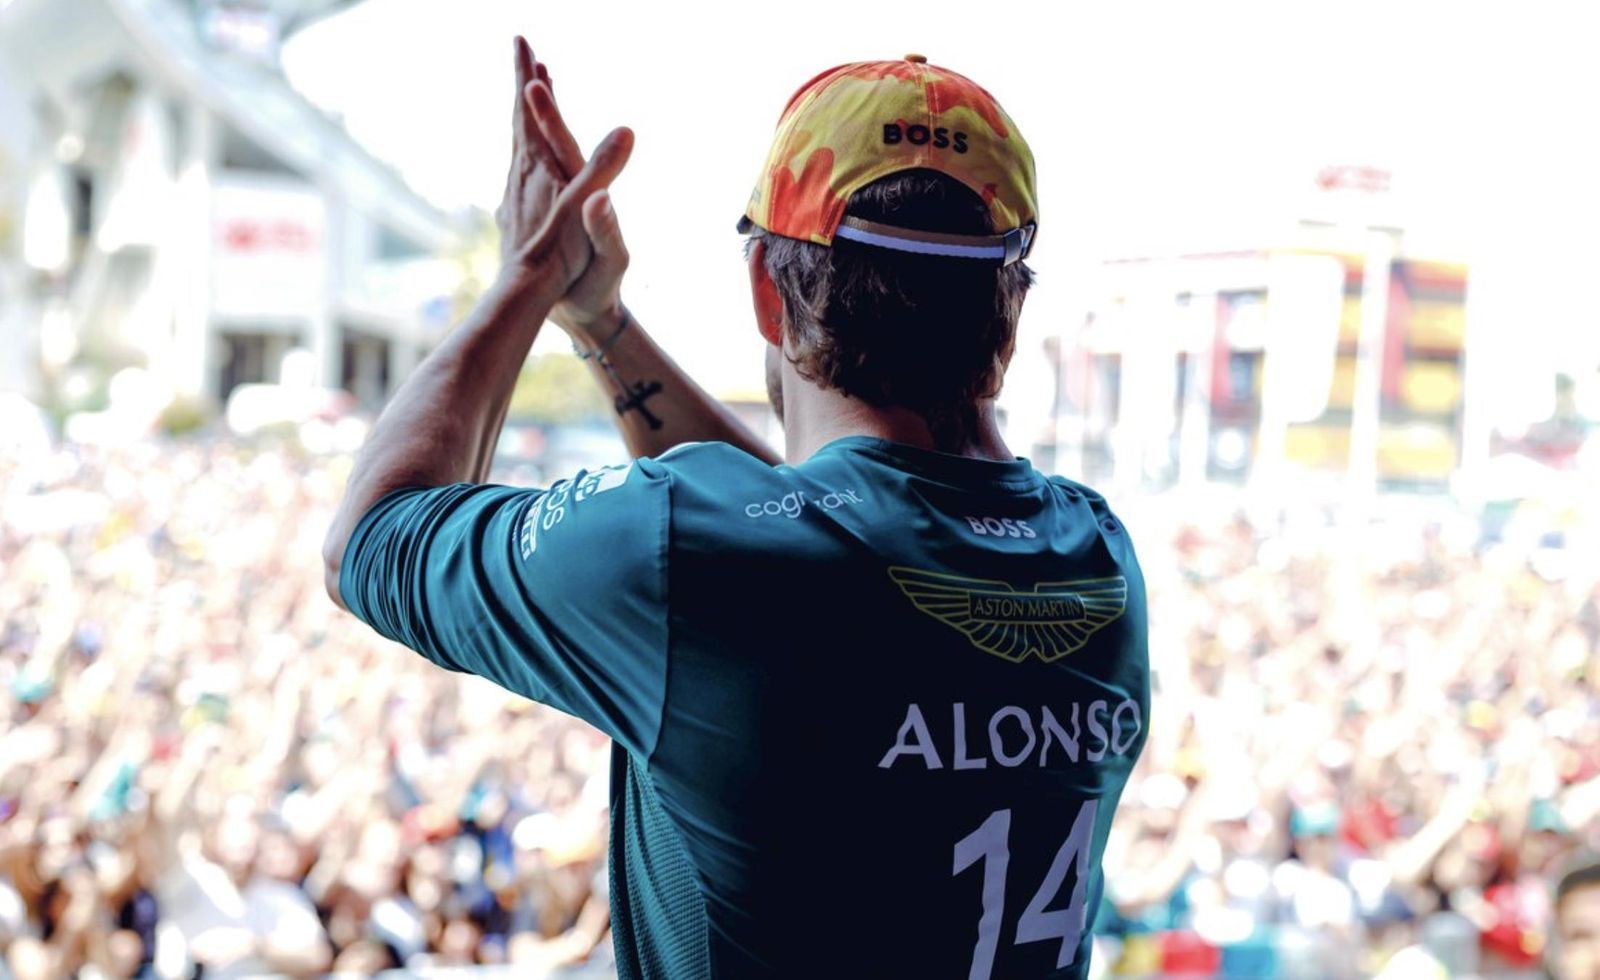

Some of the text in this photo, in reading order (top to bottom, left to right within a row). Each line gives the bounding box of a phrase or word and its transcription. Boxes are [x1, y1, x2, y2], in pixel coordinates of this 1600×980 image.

[883, 123, 968, 154] BOSS
[964, 515, 1037, 539] BOSS
[974, 599, 1082, 618] ASTON MARTIN
[877, 699, 1141, 770] ALONSO
[952, 799, 1099, 980] 14
